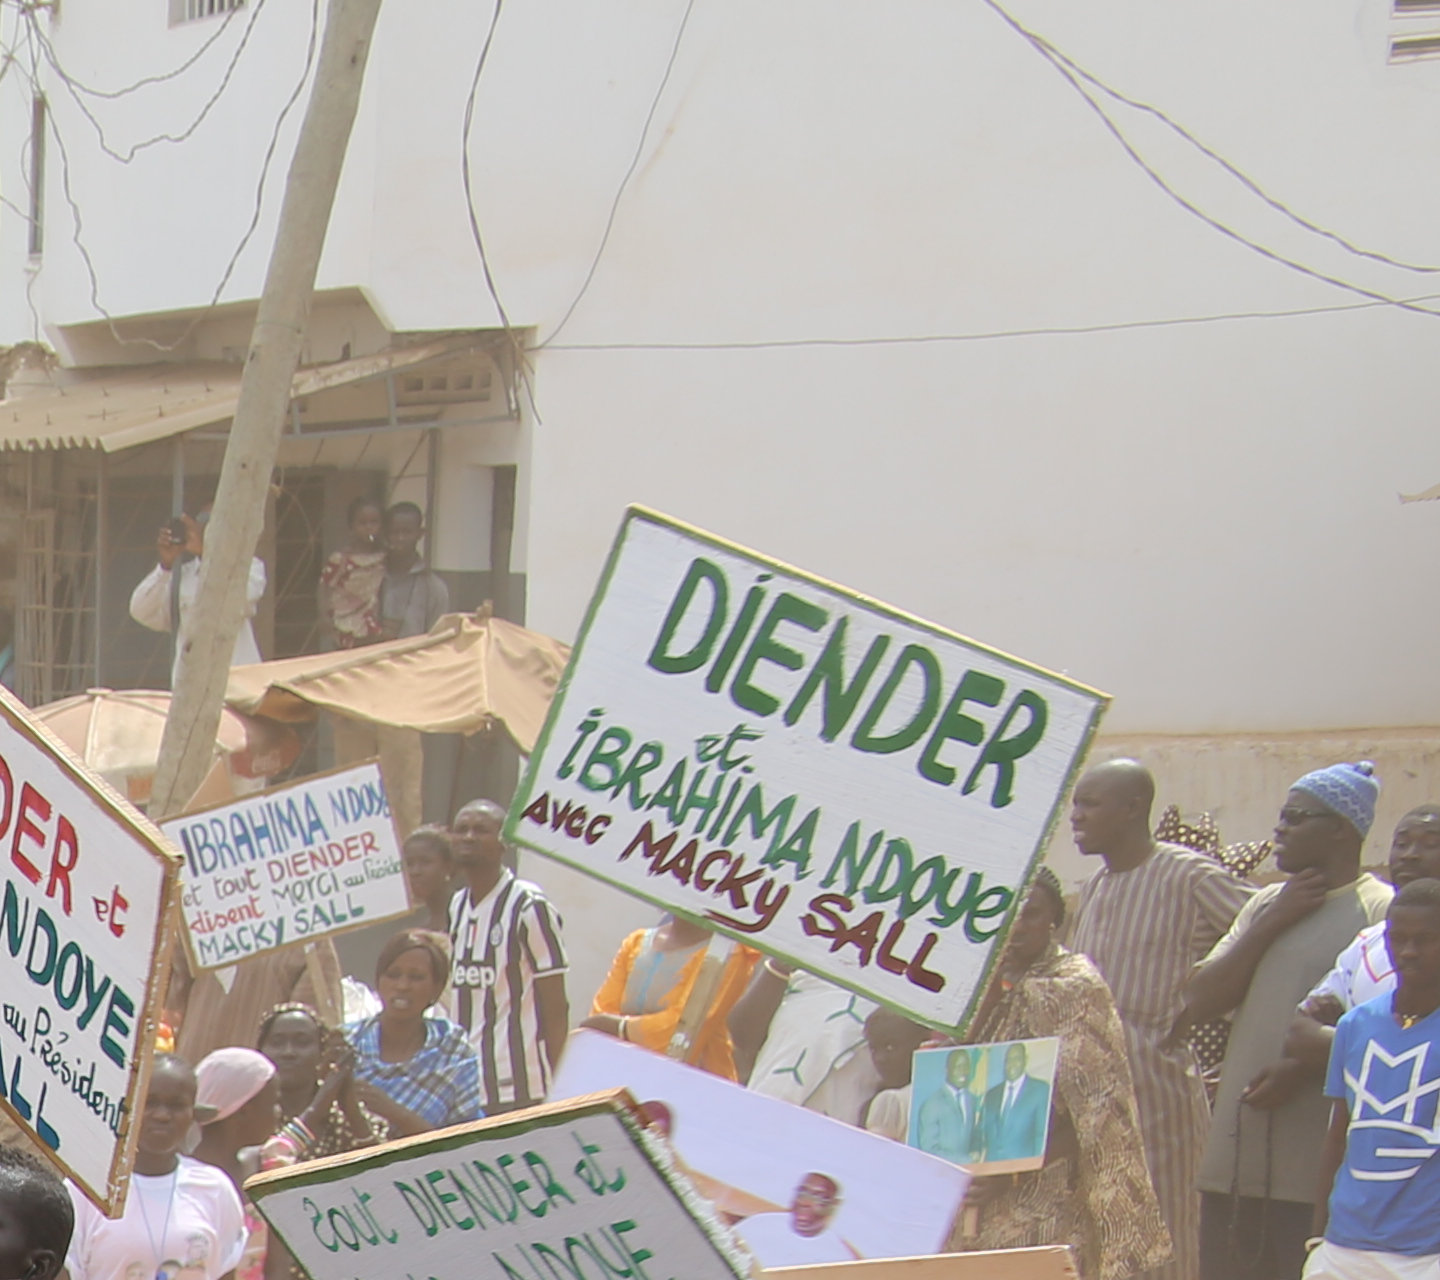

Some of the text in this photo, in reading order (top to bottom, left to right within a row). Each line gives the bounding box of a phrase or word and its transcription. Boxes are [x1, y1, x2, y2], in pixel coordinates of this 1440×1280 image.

[696, 724, 764, 774] et
[180, 793, 329, 877] IBRAHIMA
[183, 831, 380, 907] et tout DIENDER
[92, 885, 129, 939] et
[189, 895, 265, 934] disent
[198, 893, 364, 965] MACKY SALL
[799, 892, 946, 993] SALL
[455, 963, 495, 988] eep
[3, 1003, 28, 1044] au
[29, 1007, 130, 1138] Président
[394, 1149, 578, 1241] DIENDER
[574, 1131, 628, 1197] et
